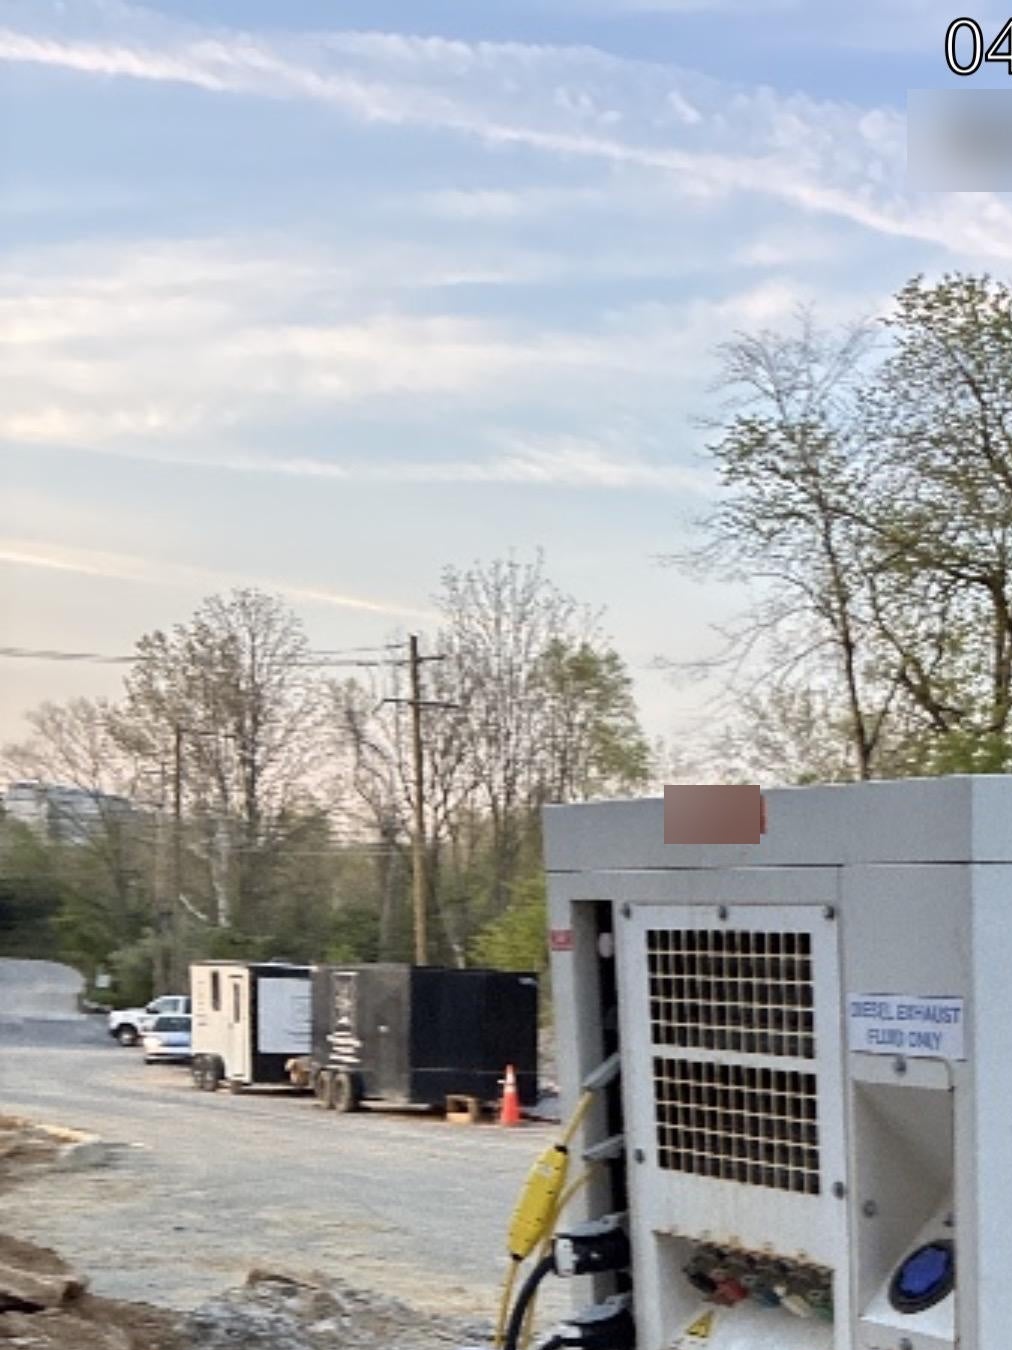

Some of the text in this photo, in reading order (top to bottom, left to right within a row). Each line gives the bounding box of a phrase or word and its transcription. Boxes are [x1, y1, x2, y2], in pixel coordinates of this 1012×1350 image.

[897, 1005, 960, 1023] EXHAUST
[867, 1029, 943, 1050] FLUID ONLY
